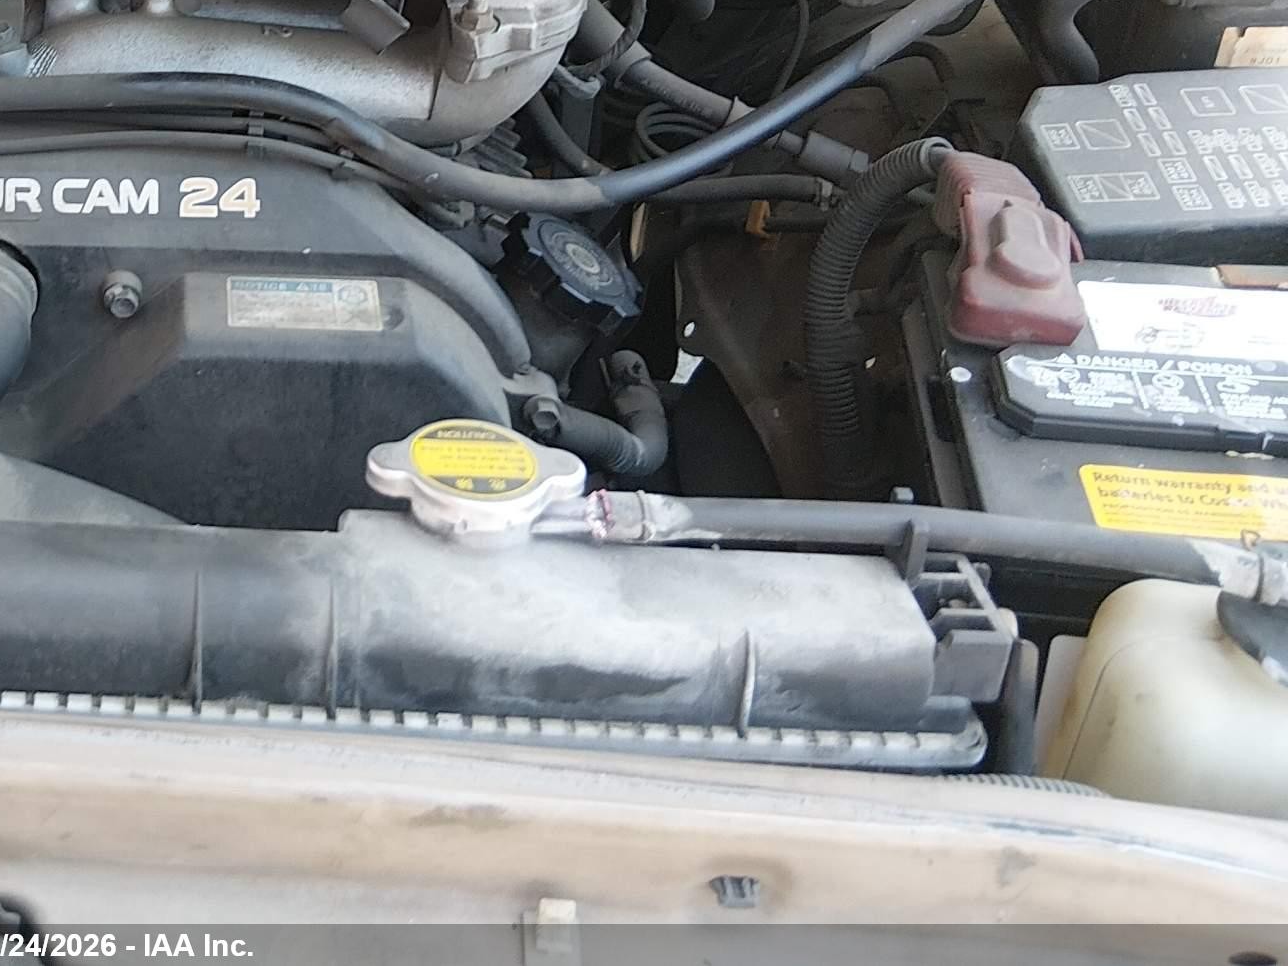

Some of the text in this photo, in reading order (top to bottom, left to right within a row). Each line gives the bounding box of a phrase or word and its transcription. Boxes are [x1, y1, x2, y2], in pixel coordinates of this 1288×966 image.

[52, 177, 160, 215] CAM
[178, 176, 261, 218] 24
[1076, 354, 1158, 371] DANGER
[1176, 359, 1253, 375] POISON
[1092, 471, 1151, 486] Return
